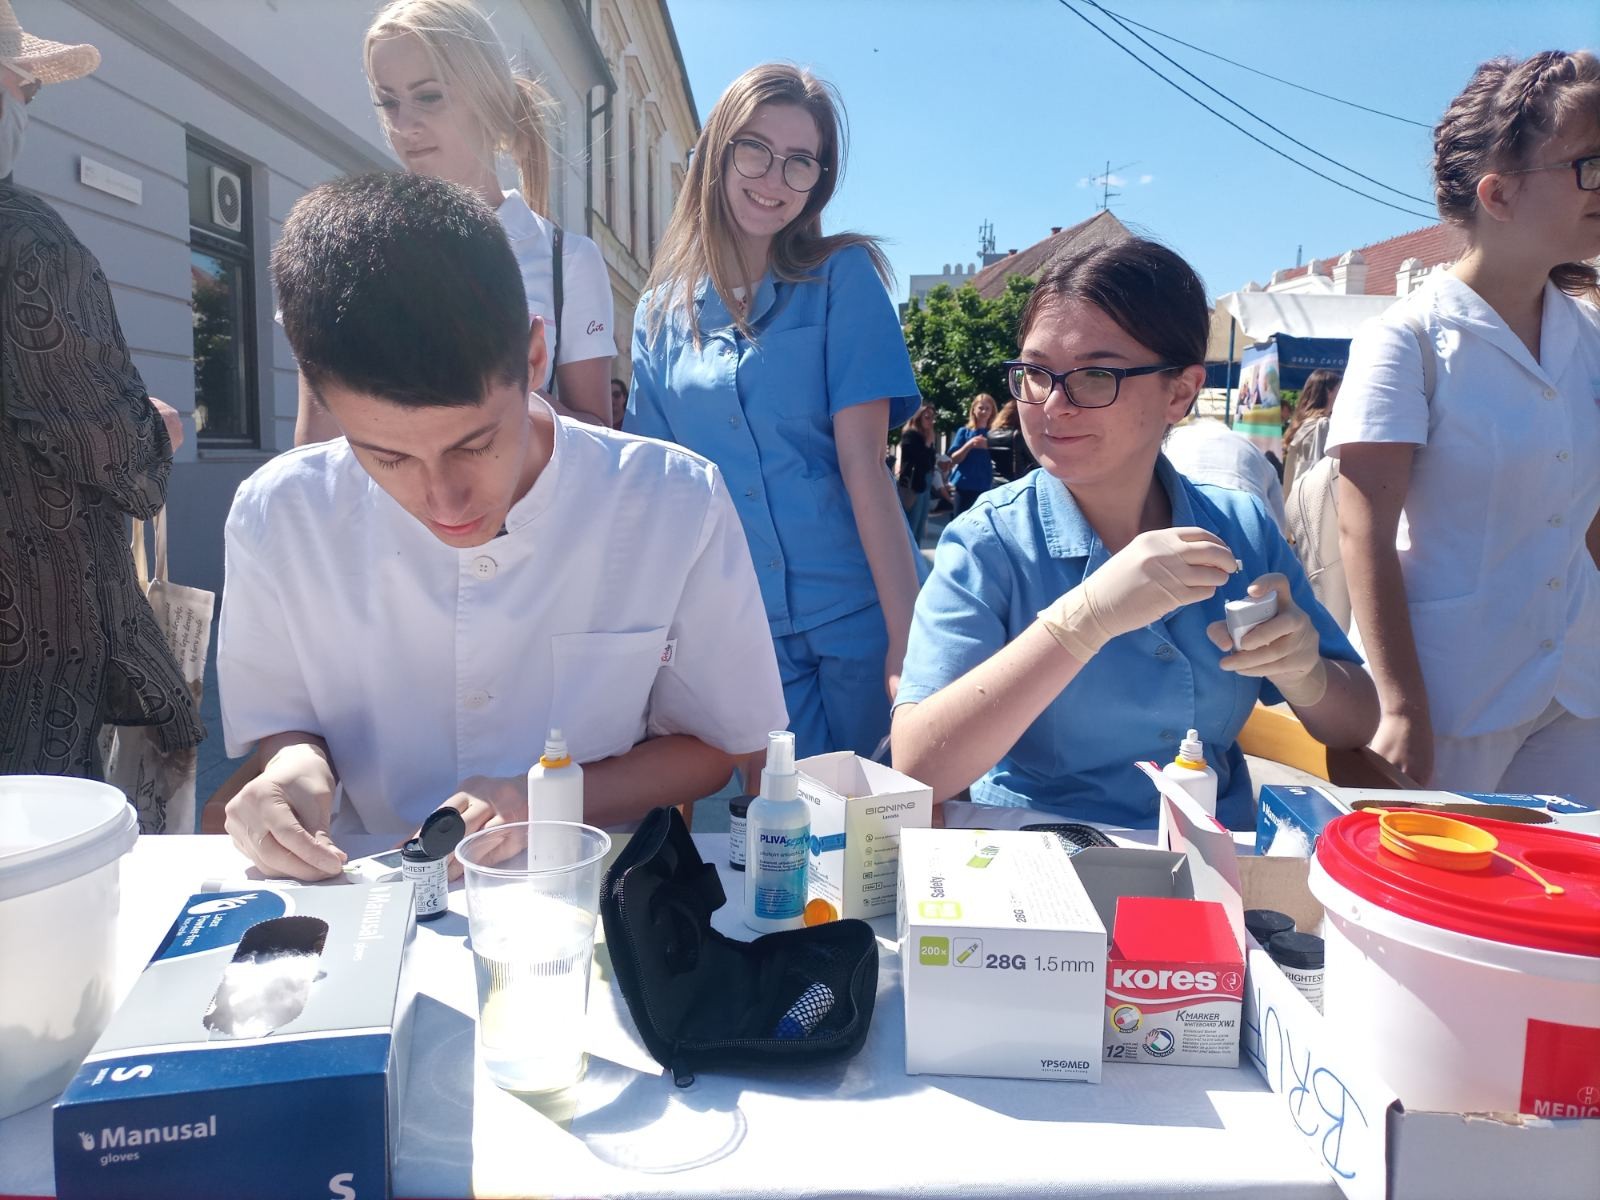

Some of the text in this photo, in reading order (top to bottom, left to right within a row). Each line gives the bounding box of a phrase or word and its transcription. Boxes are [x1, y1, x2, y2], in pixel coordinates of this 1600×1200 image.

[985, 954, 1026, 971] 28G
[1106, 1044, 1125, 1058] 12
[1040, 1059, 1090, 1070] YPSOMED
[100, 1115, 217, 1149] Manusal
[100, 1152, 140, 1167] gloves
[328, 1172, 356, 1200] S
